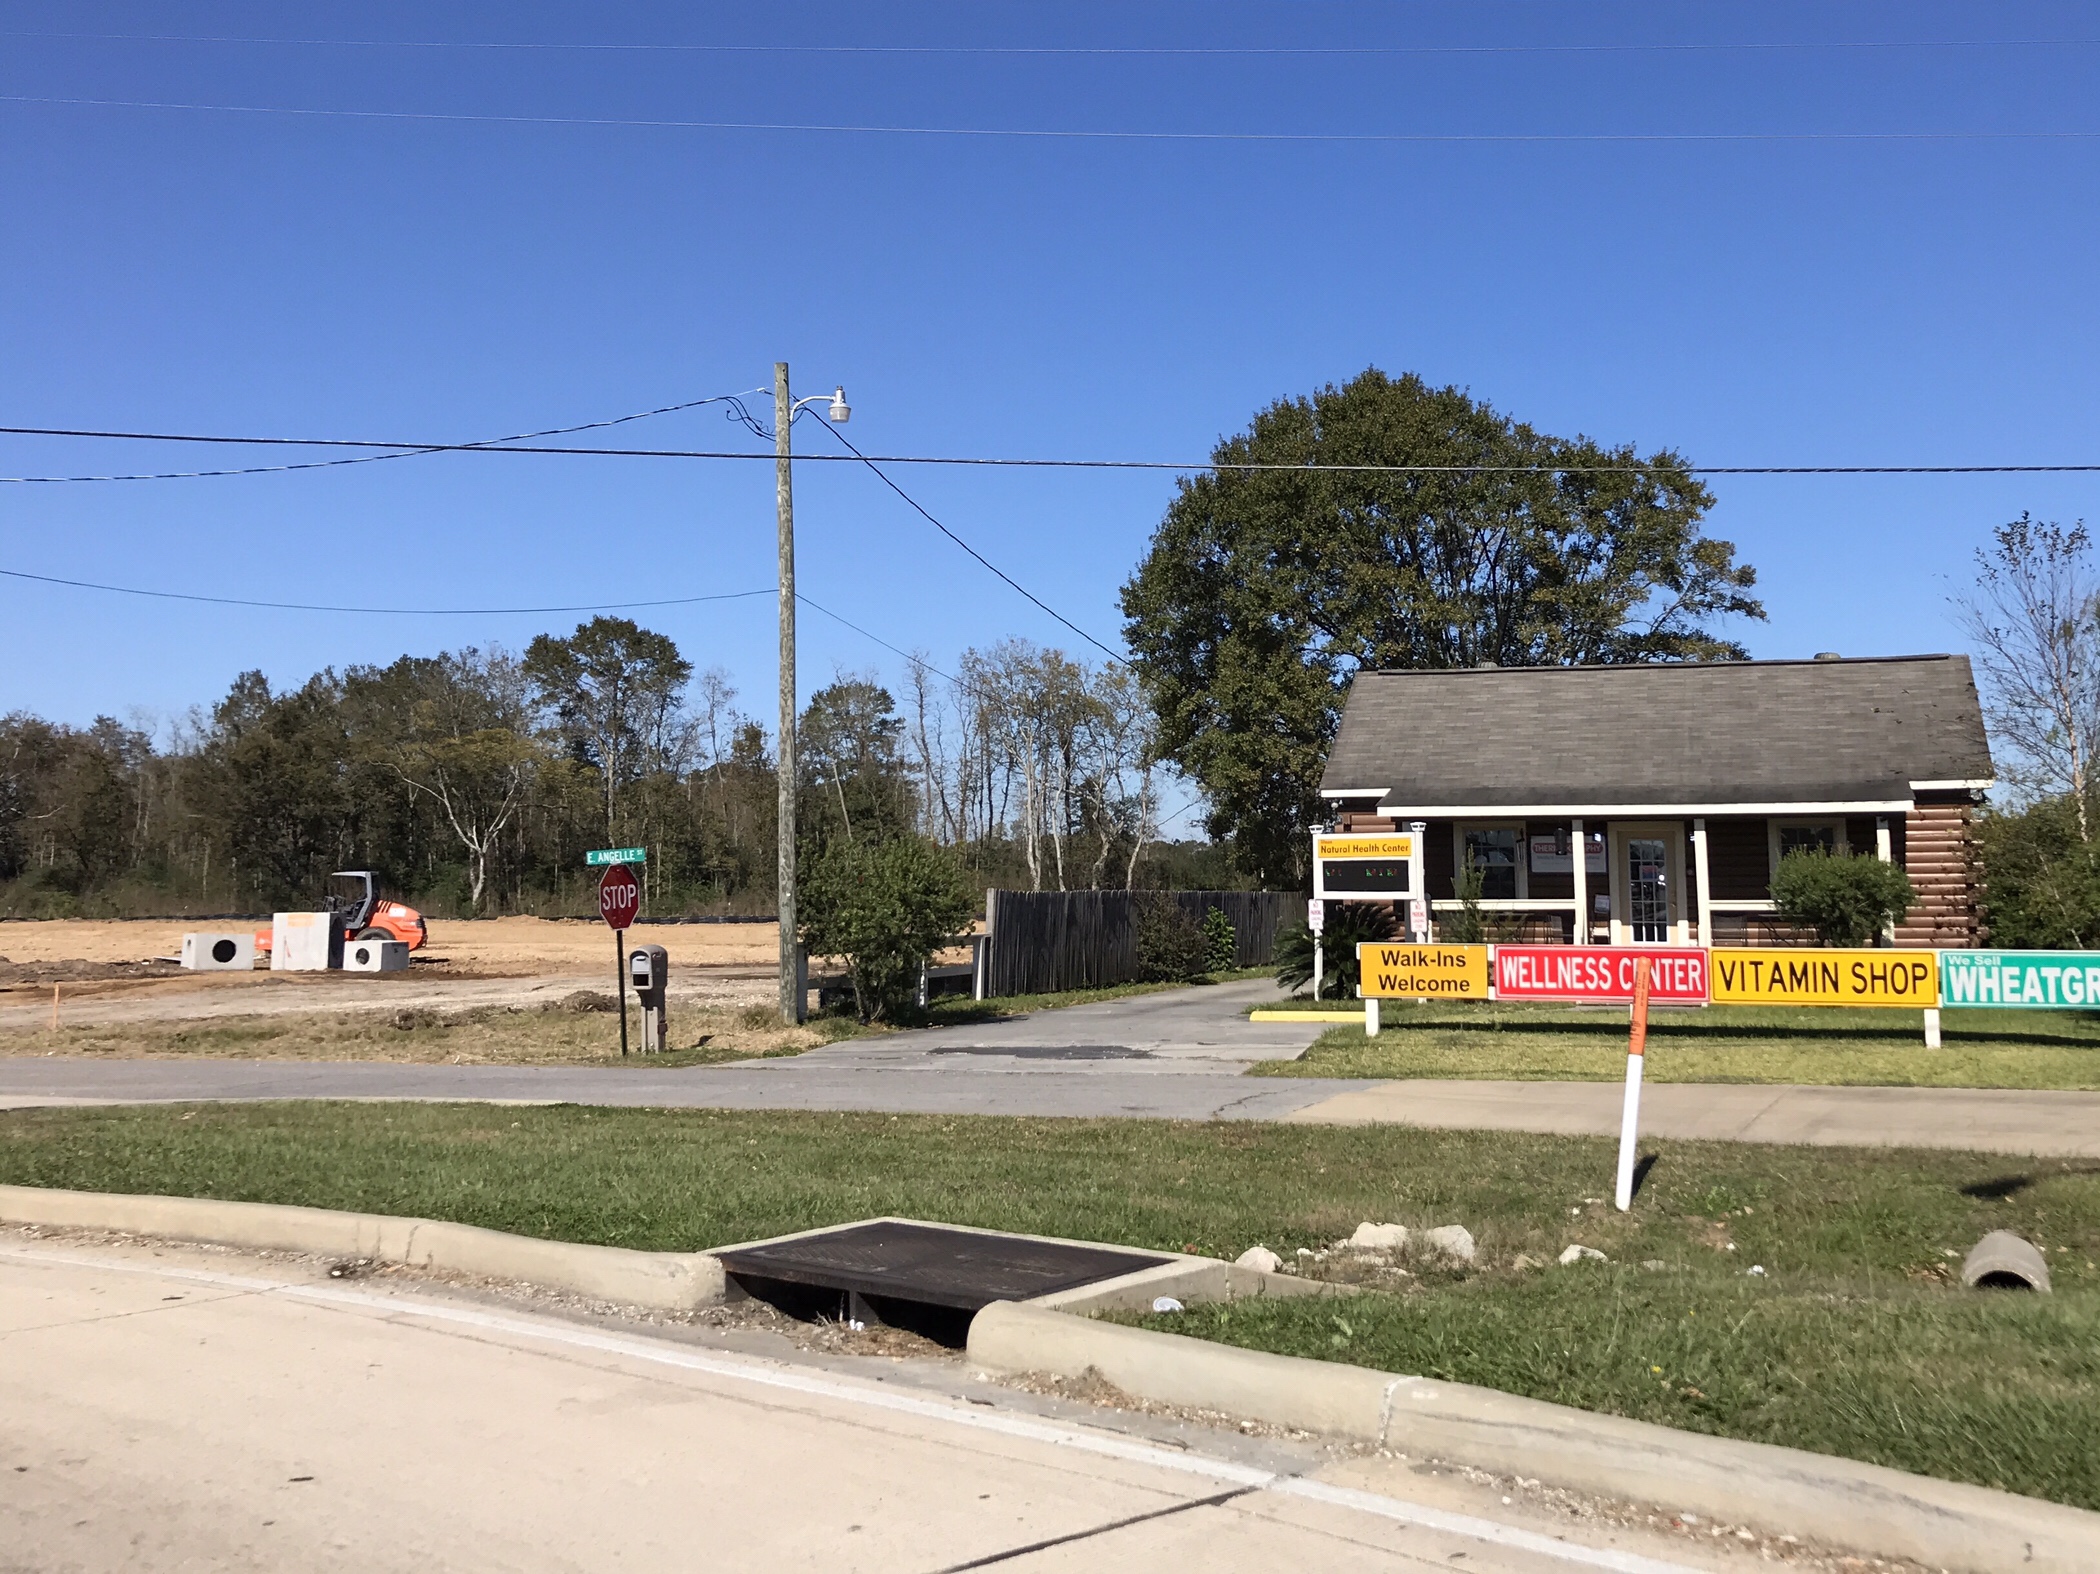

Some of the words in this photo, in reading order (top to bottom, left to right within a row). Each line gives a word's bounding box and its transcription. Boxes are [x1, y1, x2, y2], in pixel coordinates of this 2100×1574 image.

[598, 850, 635, 863] ANGELLE
[1320, 844, 1350, 854] Natural
[1352, 843, 1379, 853] Health
[1382, 843, 1409, 853] Center
[602, 883, 637, 911] STOP
[1381, 950, 1467, 968] Walk-Ins
[1947, 955, 1971, 965] We
[1974, 955, 2001, 966] Sell
[1501, 955, 1613, 991] WELLNESS
[1719, 959, 1839, 993] VITAMIN
[1851, 961, 1928, 995] SHOP
[1378, 974, 1470, 992] Welcome
[1948, 965, 2100, 1004] WHEATGR
